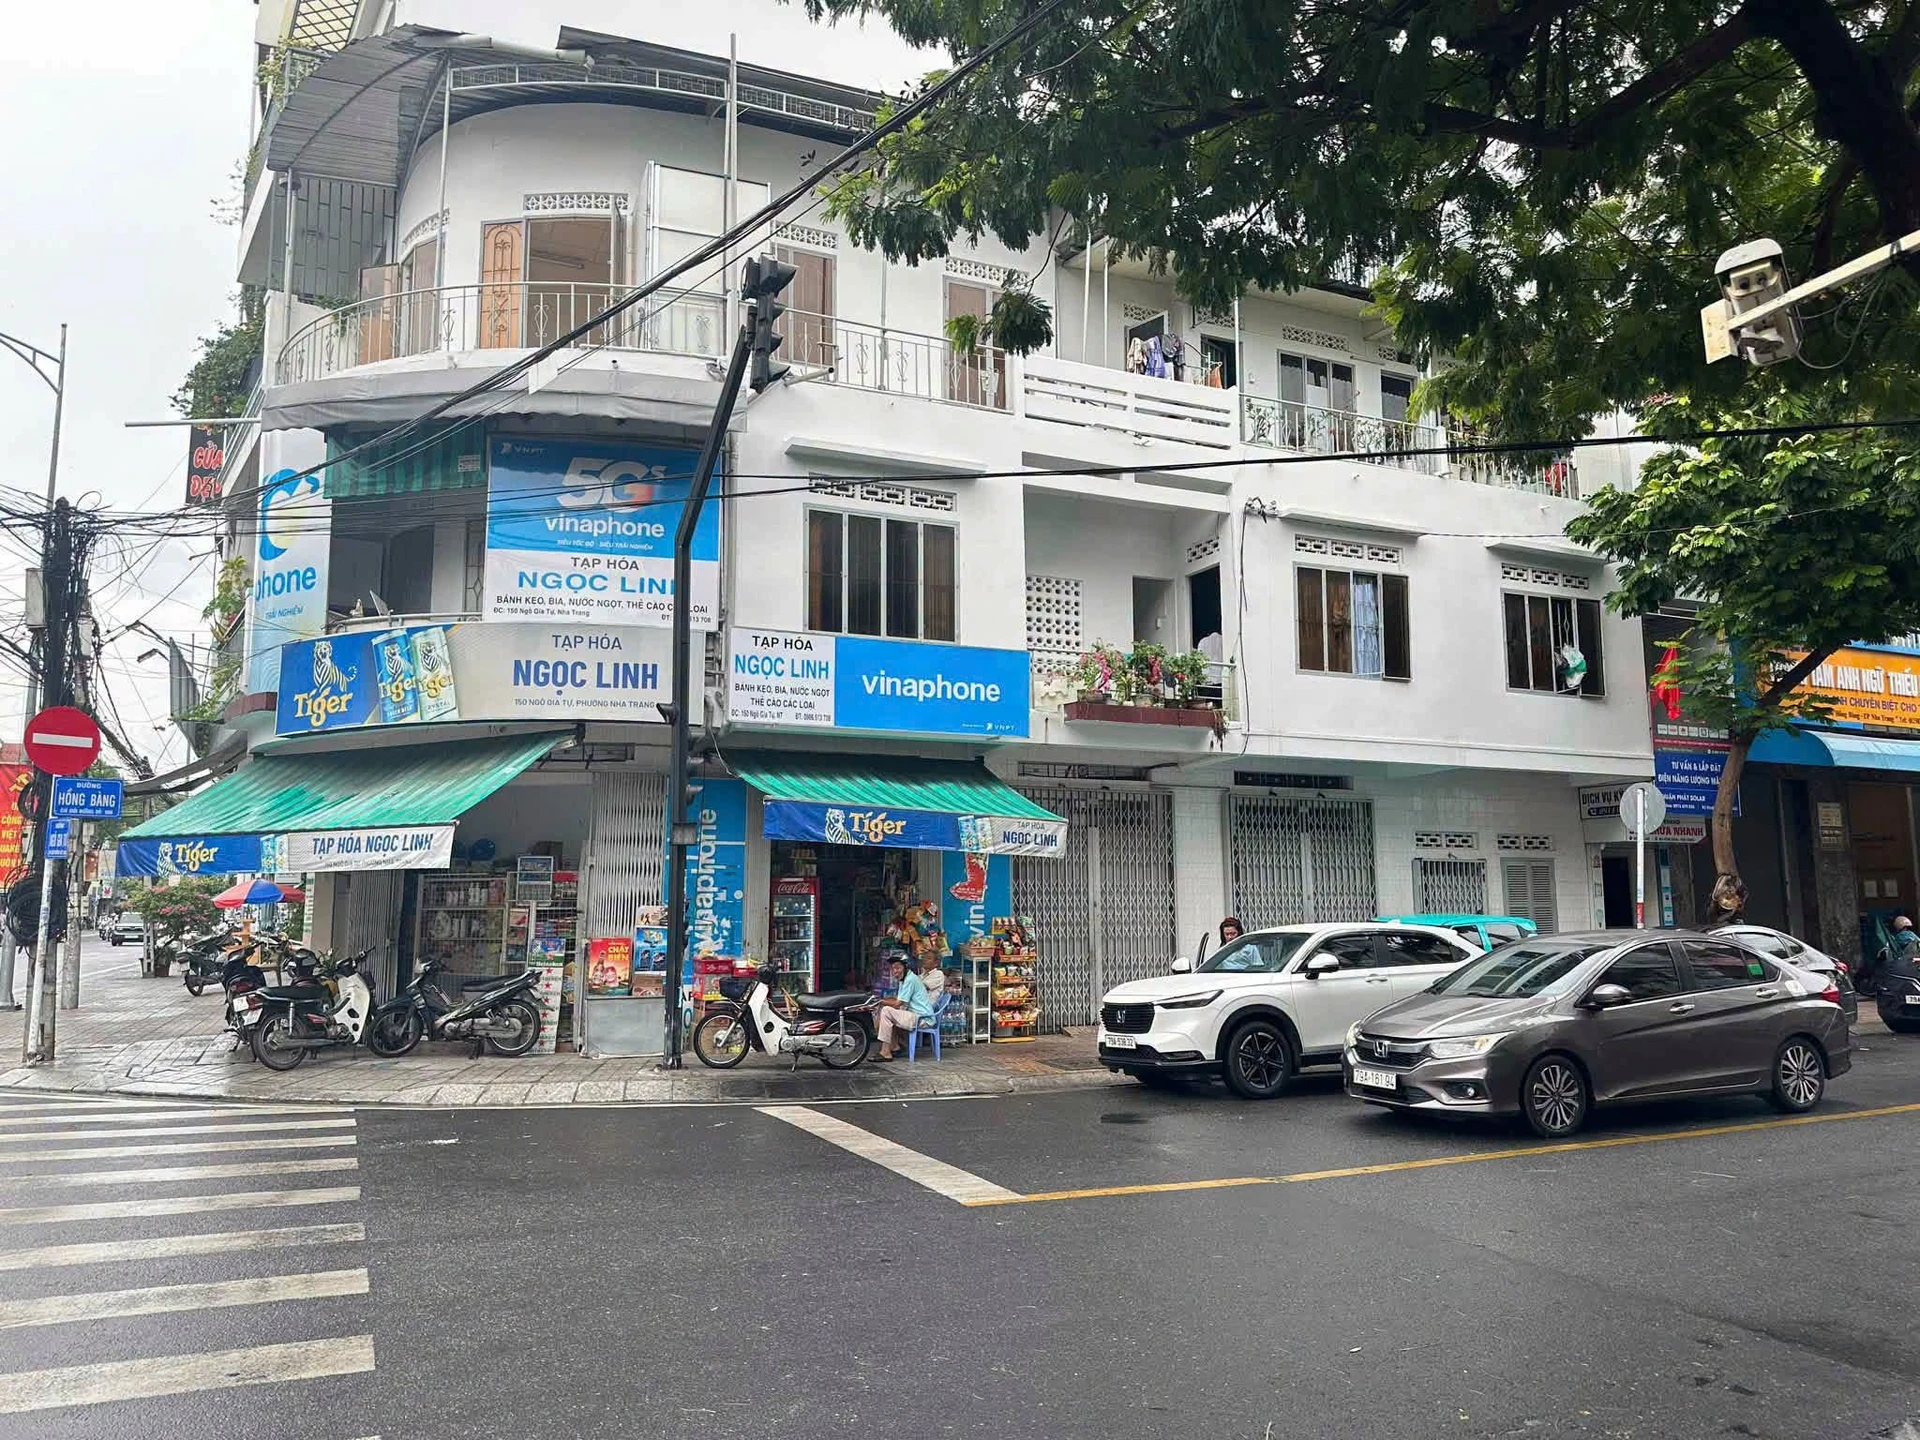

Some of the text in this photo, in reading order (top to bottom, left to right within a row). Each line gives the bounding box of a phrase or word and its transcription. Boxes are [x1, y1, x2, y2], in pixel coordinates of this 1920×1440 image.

[545, 514, 665, 538] vinaphone
[571, 557, 639, 571] TẠP HÓA
[518, 572, 608, 594] NGỌC
[548, 597, 566, 606] BIA,
[626, 599, 643, 610] THẺ
[572, 609, 590, 617] Trang
[552, 633, 622, 651] TẠP HÓA
[752, 635, 813, 651] TẠP HÓA
[734, 654, 829, 680] NGỌC LINH
[513, 659, 658, 696] NGỌC LINH
[861, 671, 1001, 702] vinaphone
[1837, 665, 1861, 691] ANH
[1861, 666, 1885, 693] NGỮ
[1888, 667, 1919, 697] THIẾU
[294, 687, 353, 727] Tiger
[515, 698, 528, 706] 150
[610, 700, 627, 708] NHA
[628, 700, 655, 708] TRANG
[1849, 696, 1881, 709] CHUYÊN
[1881, 700, 1898, 712] BIỆT
[1900, 702, 1917, 712] CHO
[58, 787, 86, 806] HỒNG
[1581, 792, 1600, 807] DỊCH
[1601, 791, 1612, 806] VỤ
[849, 811, 907, 843] Tiger
[1673, 827, 1704, 837] NHANH
[312, 838, 335, 859] TẠP
[337, 833, 361, 854] HÓA
[365, 834, 399, 858] NGỌC
[402, 833, 433, 851] LINH
[1003, 831, 1058, 848] NGỌC LINH
[175, 840, 219, 872] Tiger
[964, 904, 985, 937] vin
